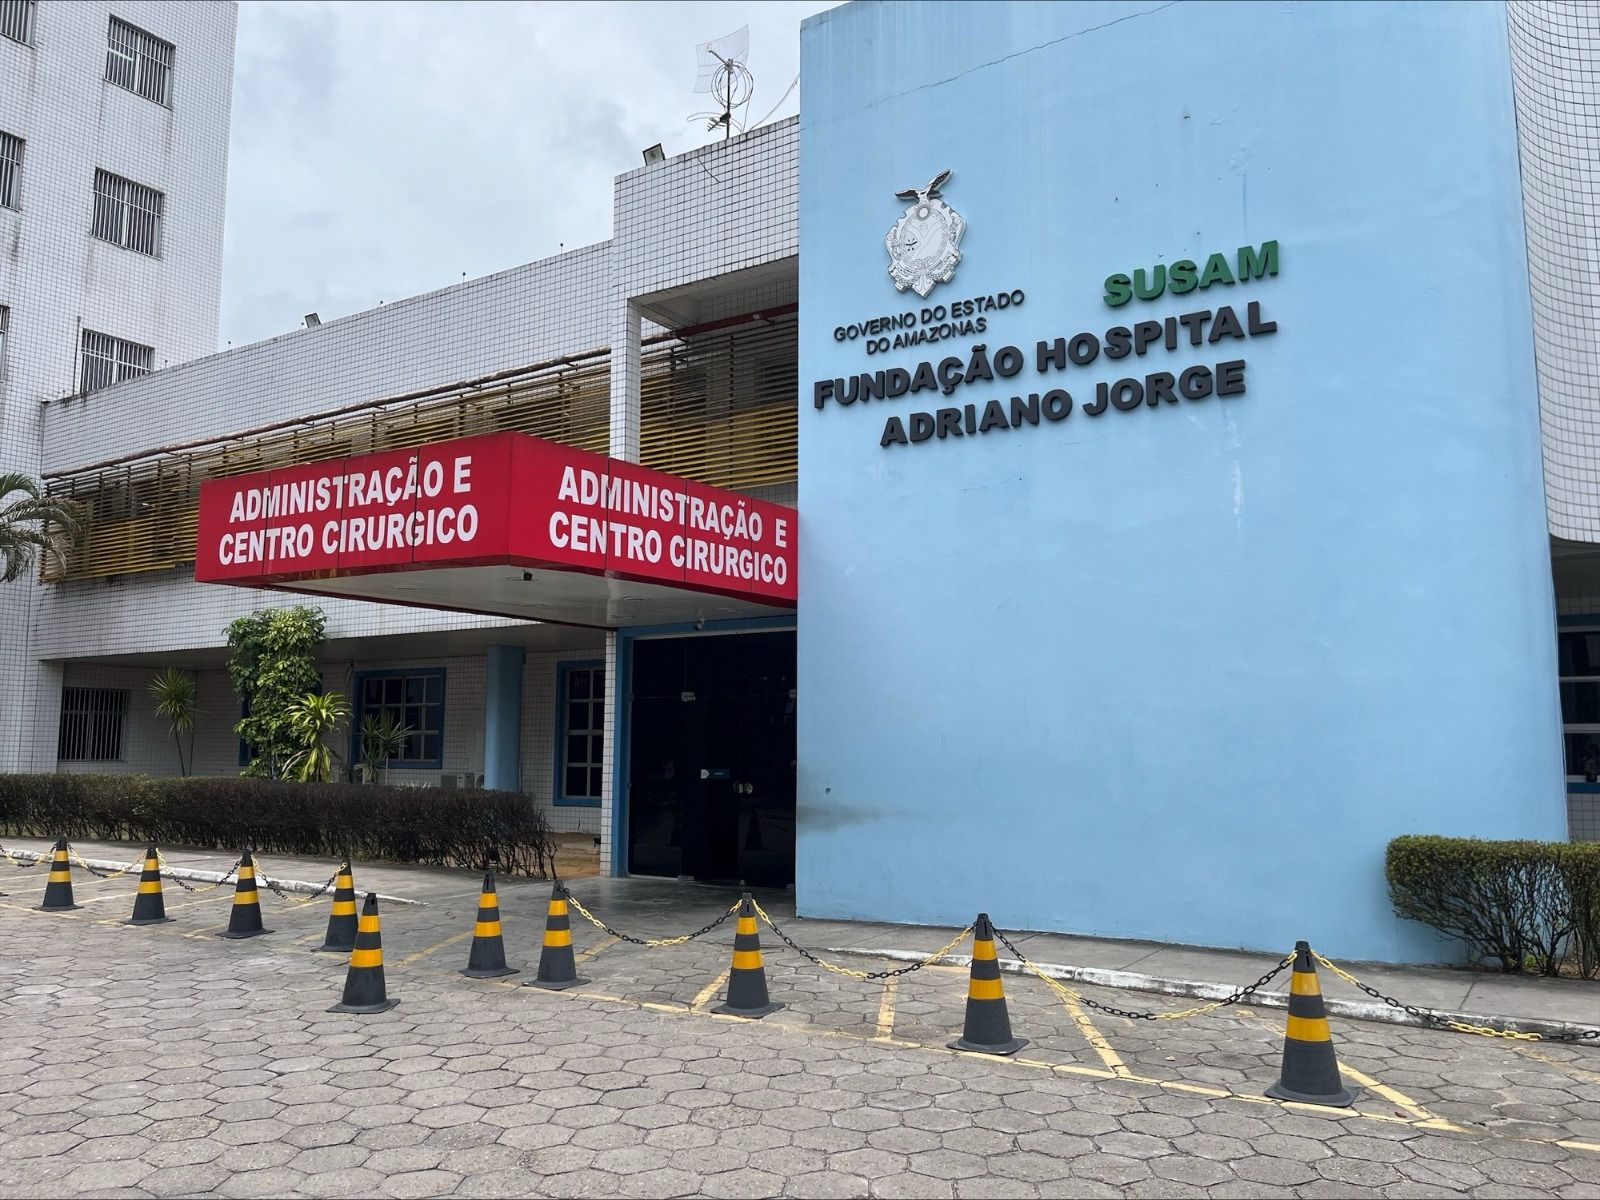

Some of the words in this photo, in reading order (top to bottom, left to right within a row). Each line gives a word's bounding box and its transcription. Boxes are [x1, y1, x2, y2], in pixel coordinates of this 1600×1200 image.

[1104, 240, 1279, 306] SUSAM
[833, 312, 917, 342] GOVERNO
[920, 306, 947, 326] DO
[951, 289, 1025, 320] ESTADO
[866, 337, 893, 355] DO
[893, 317, 987, 350] AMAZONAS
[814, 343, 1024, 409] FUNDAÇÃO
[1036, 301, 1277, 373] HOSPITAL
[880, 389, 1073, 447] ADRIANO
[1082, 359, 1246, 417] JORGE
[229, 456, 444, 523] ADMINISTRAÇÃO
[453, 456, 472, 493] E
[558, 466, 762, 542] ADMINISTRAÇÃO
[775, 518, 787, 548] E
[219, 523, 314, 565] CENTRO
[322, 504, 479, 554] CIRURGICO
[550, 511, 662, 564] CENTRO
[669, 534, 787, 585] CIRURGICO
